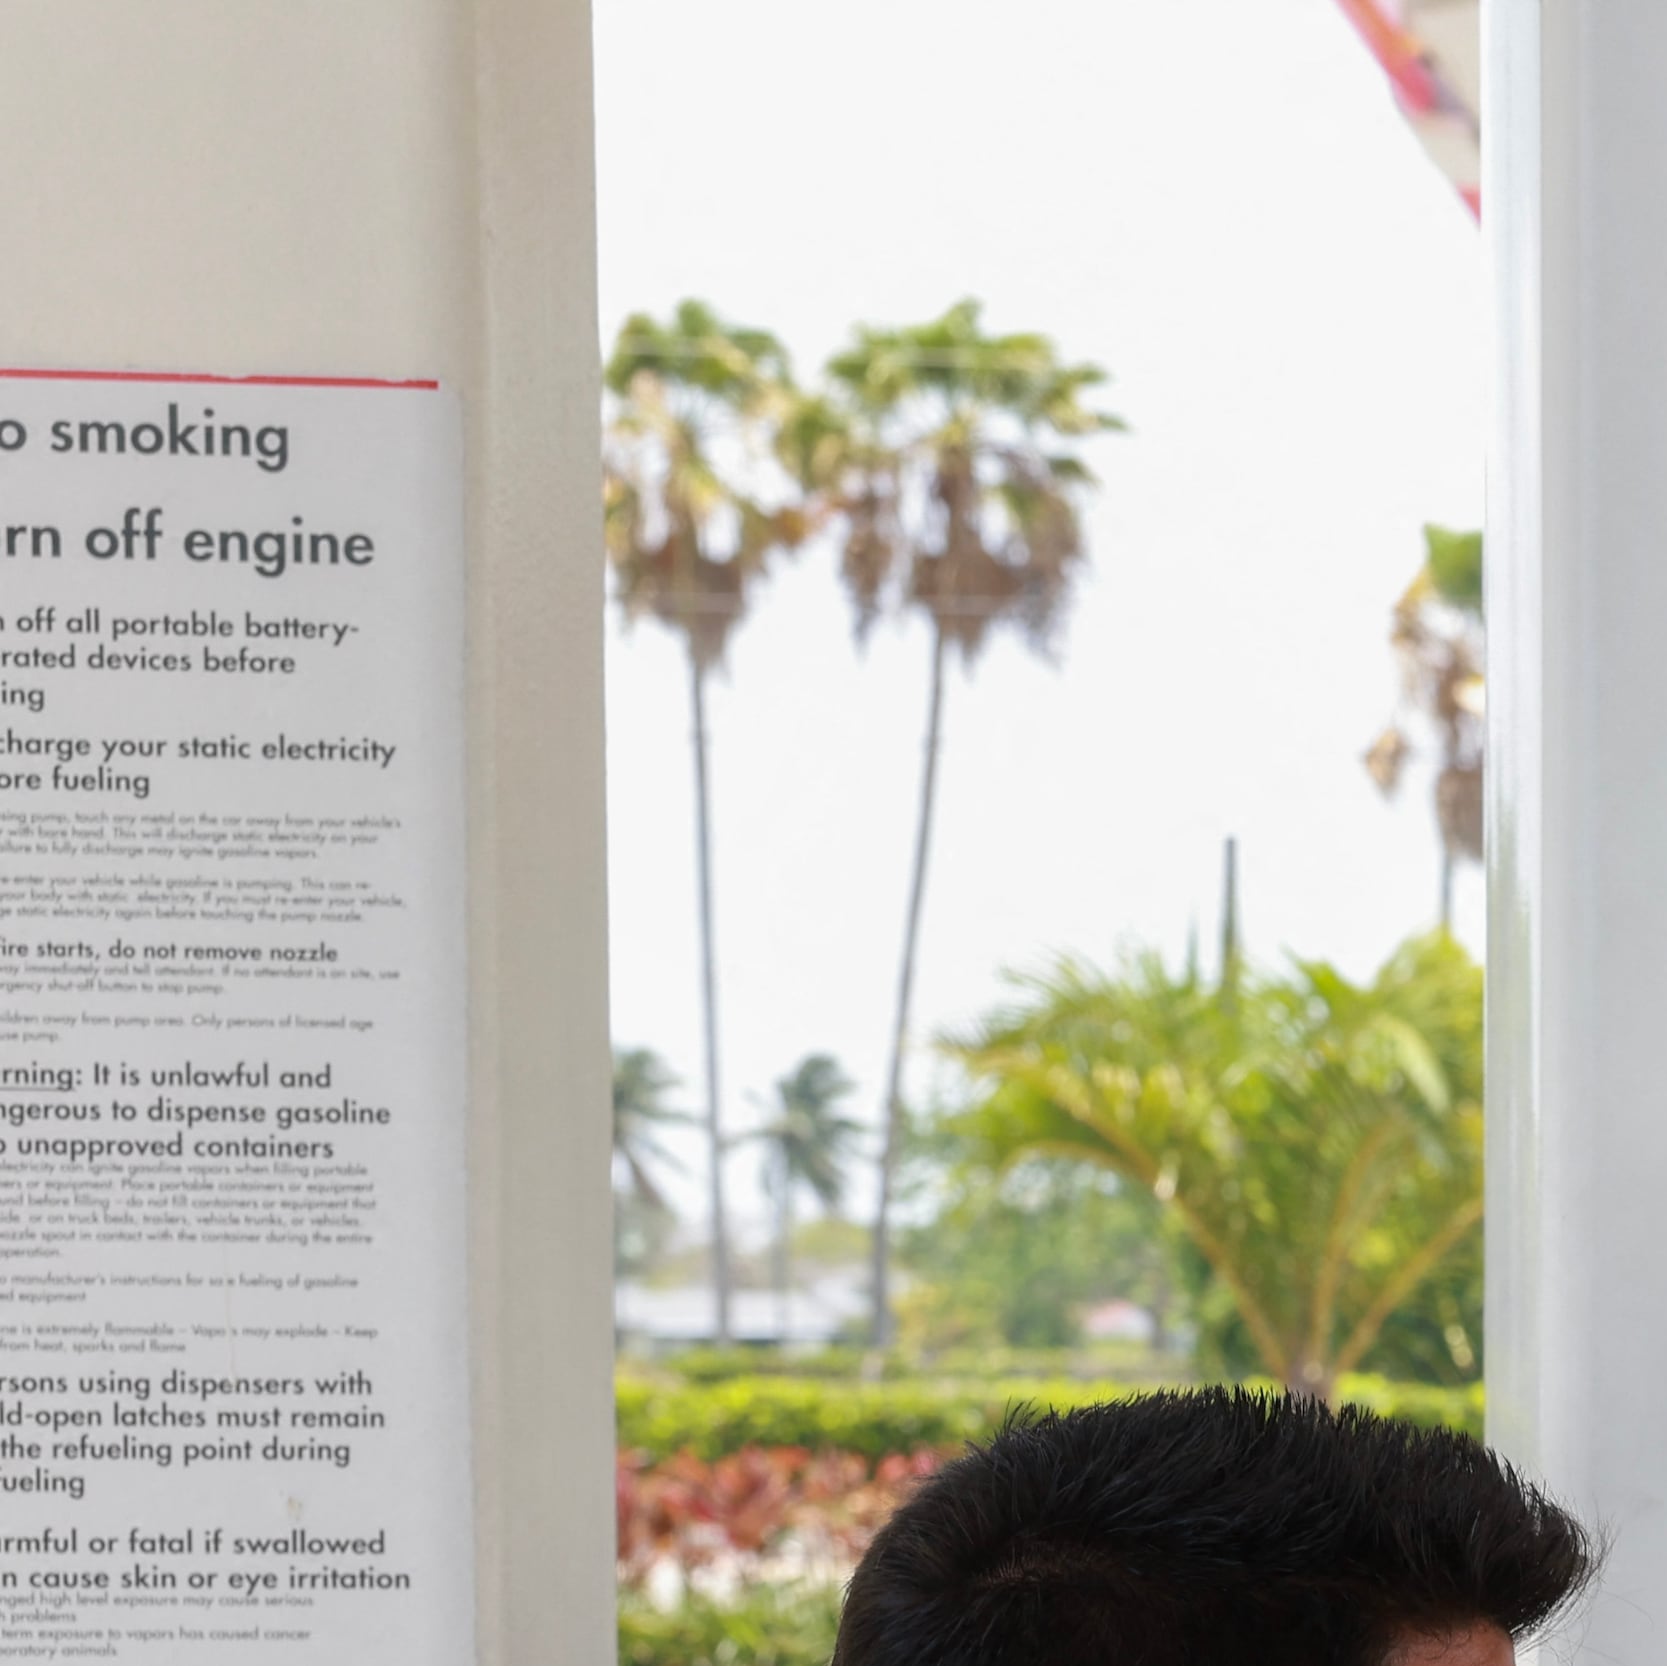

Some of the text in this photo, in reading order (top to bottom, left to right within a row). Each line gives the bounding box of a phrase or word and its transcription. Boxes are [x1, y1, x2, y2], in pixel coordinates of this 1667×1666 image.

[50, 401, 289, 473] smoking
[83, 506, 374, 579] off engine
[15, 605, 358, 647] off all portable battery-
[98, 732, 396, 769] your static electricity
[28, 1562, 410, 1594] cause skin or eye irritation
